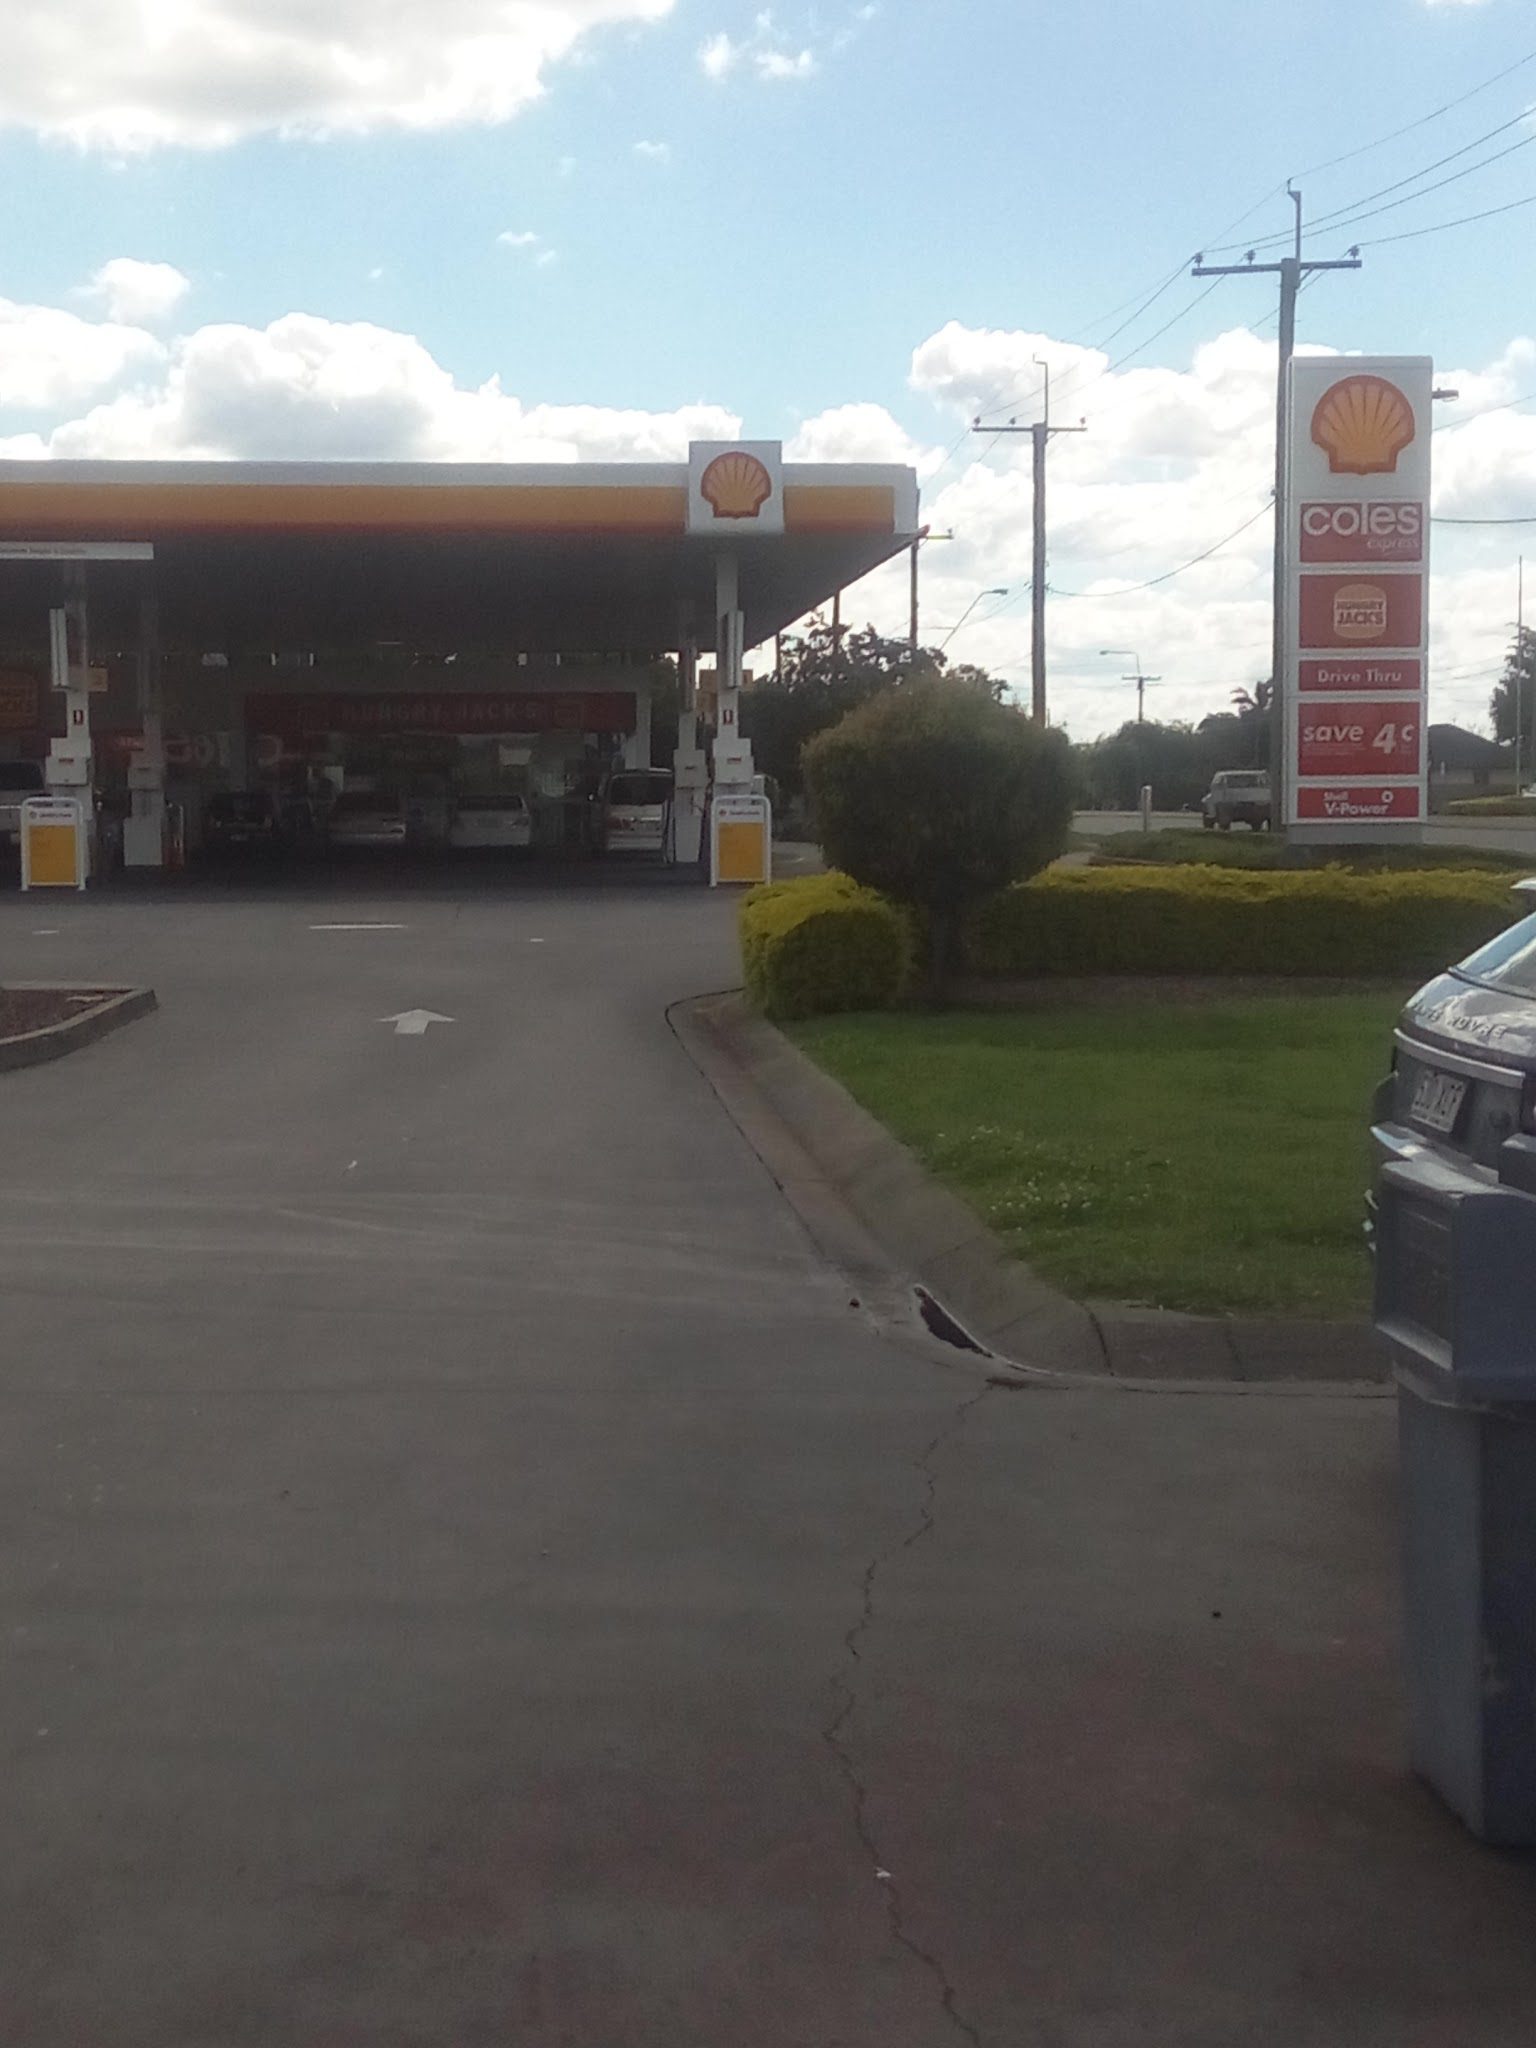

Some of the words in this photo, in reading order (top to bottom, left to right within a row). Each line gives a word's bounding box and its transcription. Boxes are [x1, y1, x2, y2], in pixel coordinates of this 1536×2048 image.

[1302, 503, 1420, 536] coles
[1366, 537, 1419, 553] express
[1318, 668, 1361, 682] Drive
[1366, 669, 1402, 682] Thru
[1303, 725, 1365, 742] save
[1325, 803, 1390, 815] V-Power
